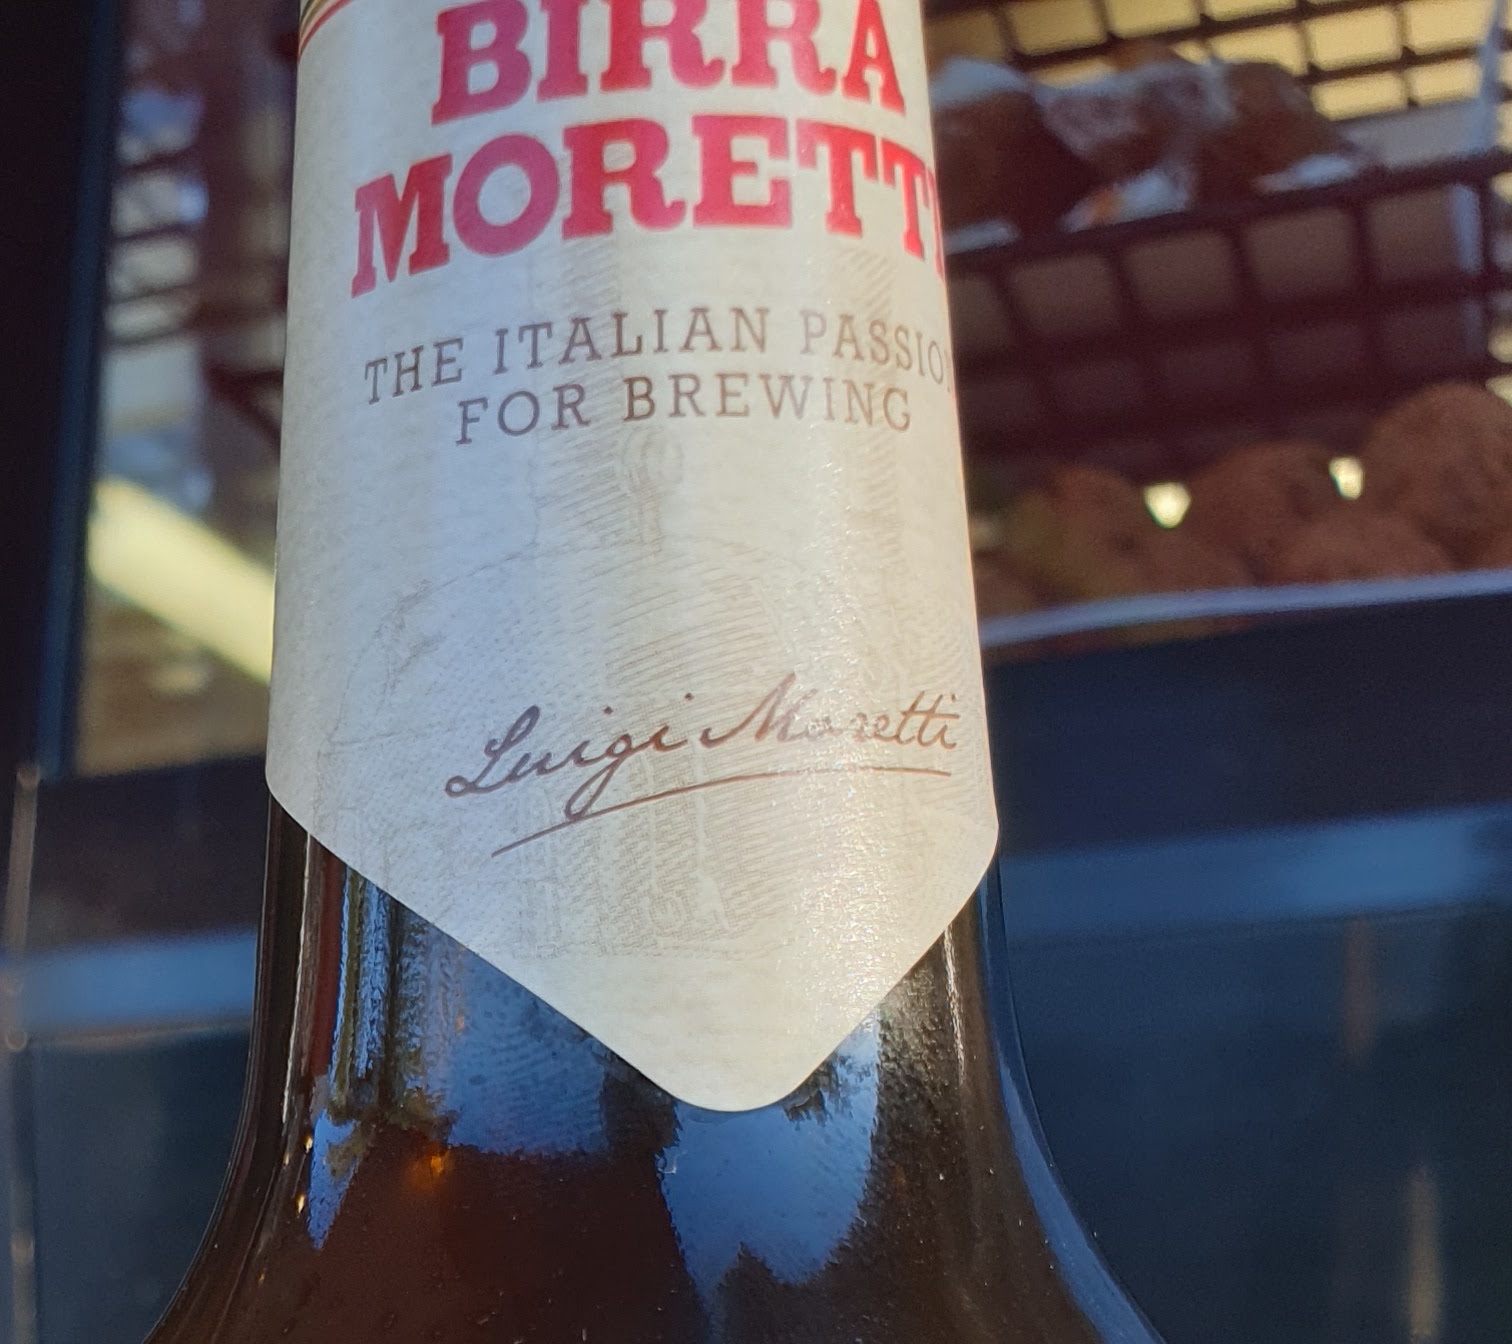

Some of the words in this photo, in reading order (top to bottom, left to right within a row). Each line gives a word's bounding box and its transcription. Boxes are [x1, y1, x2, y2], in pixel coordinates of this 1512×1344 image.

[431, 0, 906, 126] BIRRA
[363, 337, 465, 405] THE
[492, 306, 769, 375] ITALIAN
[799, 308, 950, 394] PASSIO
[455, 382, 591, 446] FOR
[623, 373, 911, 433] BREWING
[443, 692, 690, 823] Luigi
